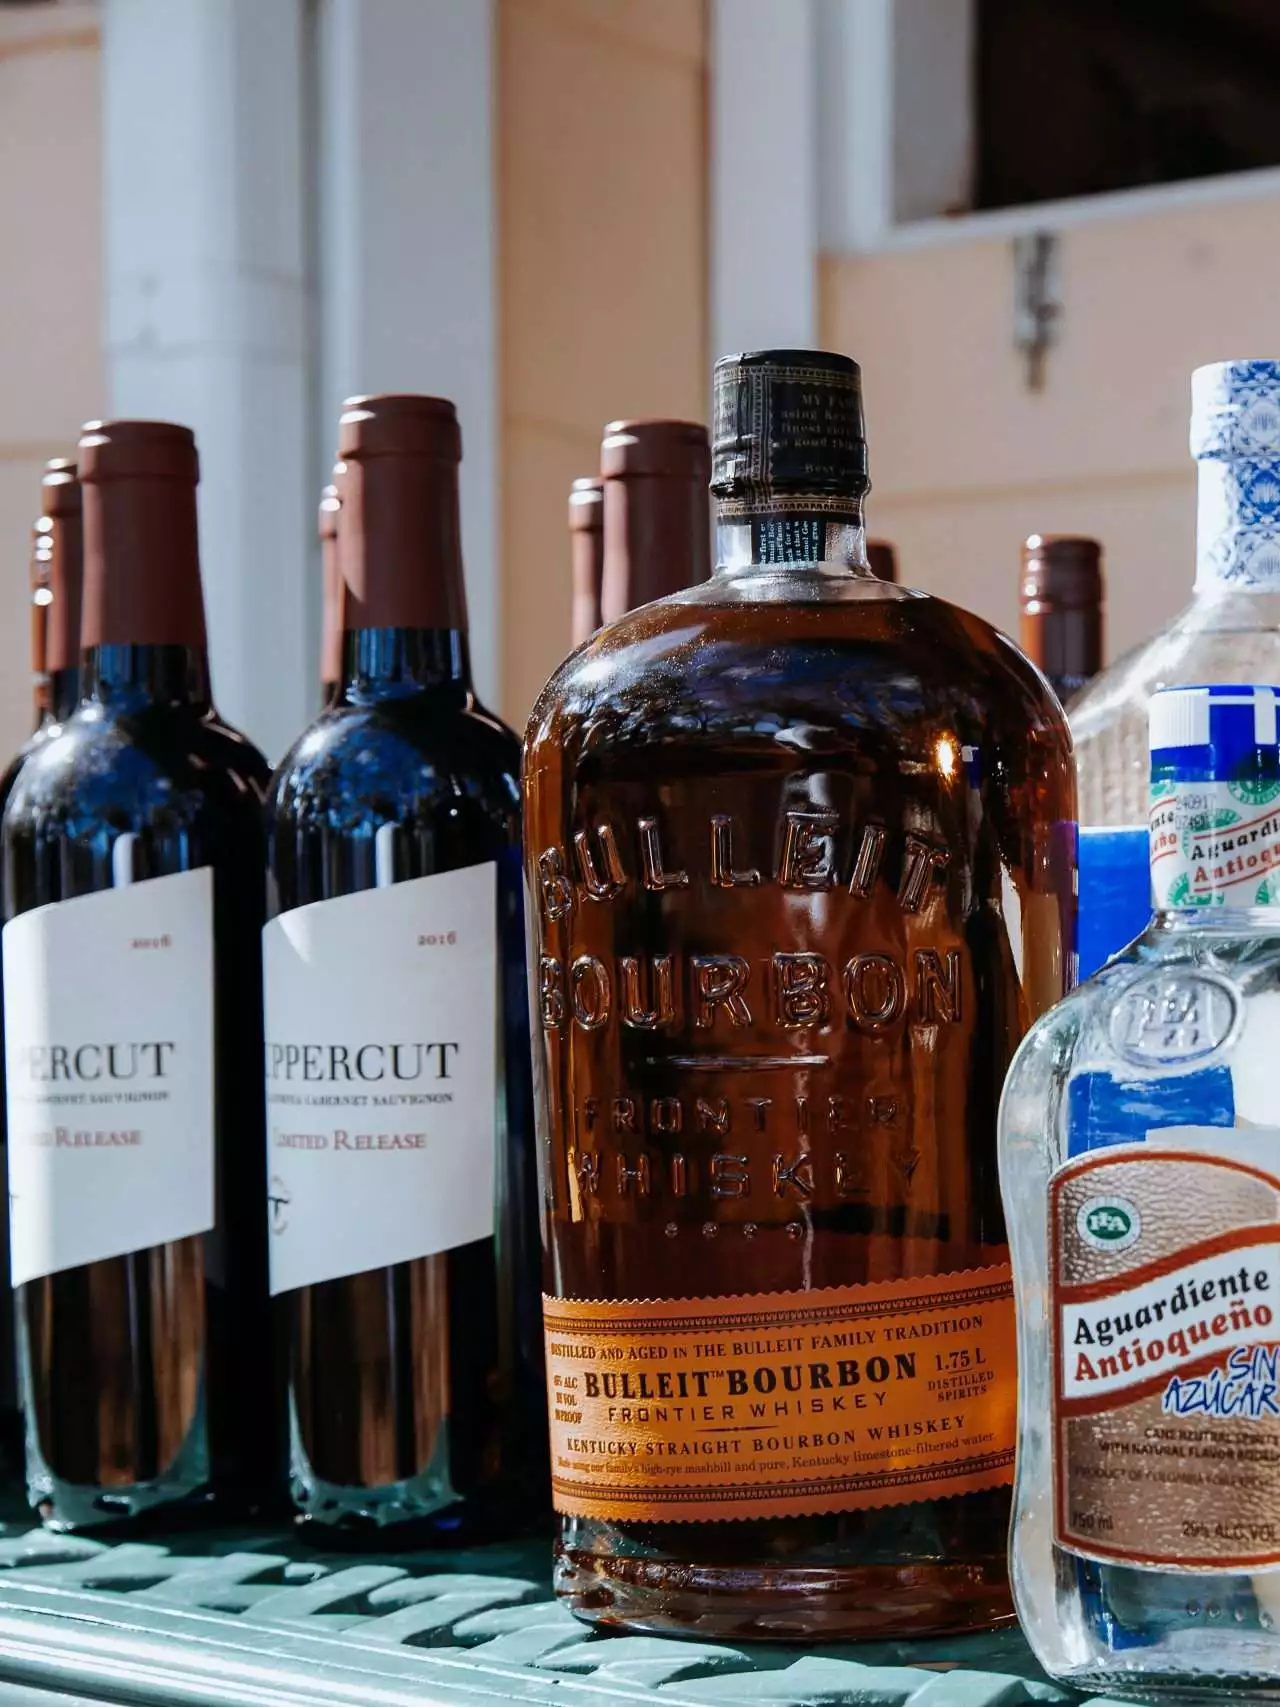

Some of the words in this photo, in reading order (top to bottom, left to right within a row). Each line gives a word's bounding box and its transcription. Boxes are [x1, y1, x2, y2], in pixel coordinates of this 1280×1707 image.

[538, 810, 951, 921] BULLEIT
[417, 931, 457, 947] 2016
[538, 946, 964, 1032] BOURBON
[28, 1041, 175, 1082] ERCUT
[266, 1042, 460, 1082] PPERCUT
[373, 1092, 454, 1107] SAUVIGNON
[583, 1096, 899, 1134] FRONTIER
[333, 1129, 428, 1151] RELEASE
[578, 1149, 922, 1198] WHISKEY
[1073, 1267, 1270, 1347] Aguardiente
[551, 1342, 596, 1359] DISTILLED
[600, 1347, 623, 1360] AND
[628, 1346, 668, 1360] AGED
[674, 1346, 687, 1359] IN
[693, 1343, 727, 1358] THE
[733, 1337, 805, 1356] BULLEIT
[811, 1330, 876, 1350] FAMILY
[883, 1315, 984, 1342] TRADITION
[1074, 1300, 1273, 1381] Antioqueño
[727, 1352, 917, 1396] BOURBON
[935, 1349, 970, 1371] 1.75
[975, 1347, 986, 1364] L
[1228, 1347, 1280, 1382] SIN
[928, 1370, 994, 1391] DISTILLED
[937, 1384, 987, 1402] SPIRITS
[1163, 1370, 1280, 1416] AZÚCAR
[608, 1405, 735, 1422] FRONTIER
[750, 1391, 887, 1418] WHISKEY
[567, 1437, 637, 1456] KENTUCKY
[646, 1440, 742, 1456] STRAIGHT
[752, 1430, 856, 1452] BOURBON
[868, 1415, 965, 1440] WHISKEY
[1099, 1442, 1130, 1454] WITH
[1132, 1444, 1185, 1458] NATURAL
[1189, 1447, 1234, 1460] FLAVOR
[642, 1461, 683, 1476] high-rye
[685, 1461, 731, 1474] mashbill
[735, 1460, 756, 1473] and
[760, 1460, 790, 1475] pure,
[792, 1452, 850, 1468] Kentucky
[854, 1437, 959, 1462] limestone-filtered
[1129, 1469, 1142, 1481] OF
